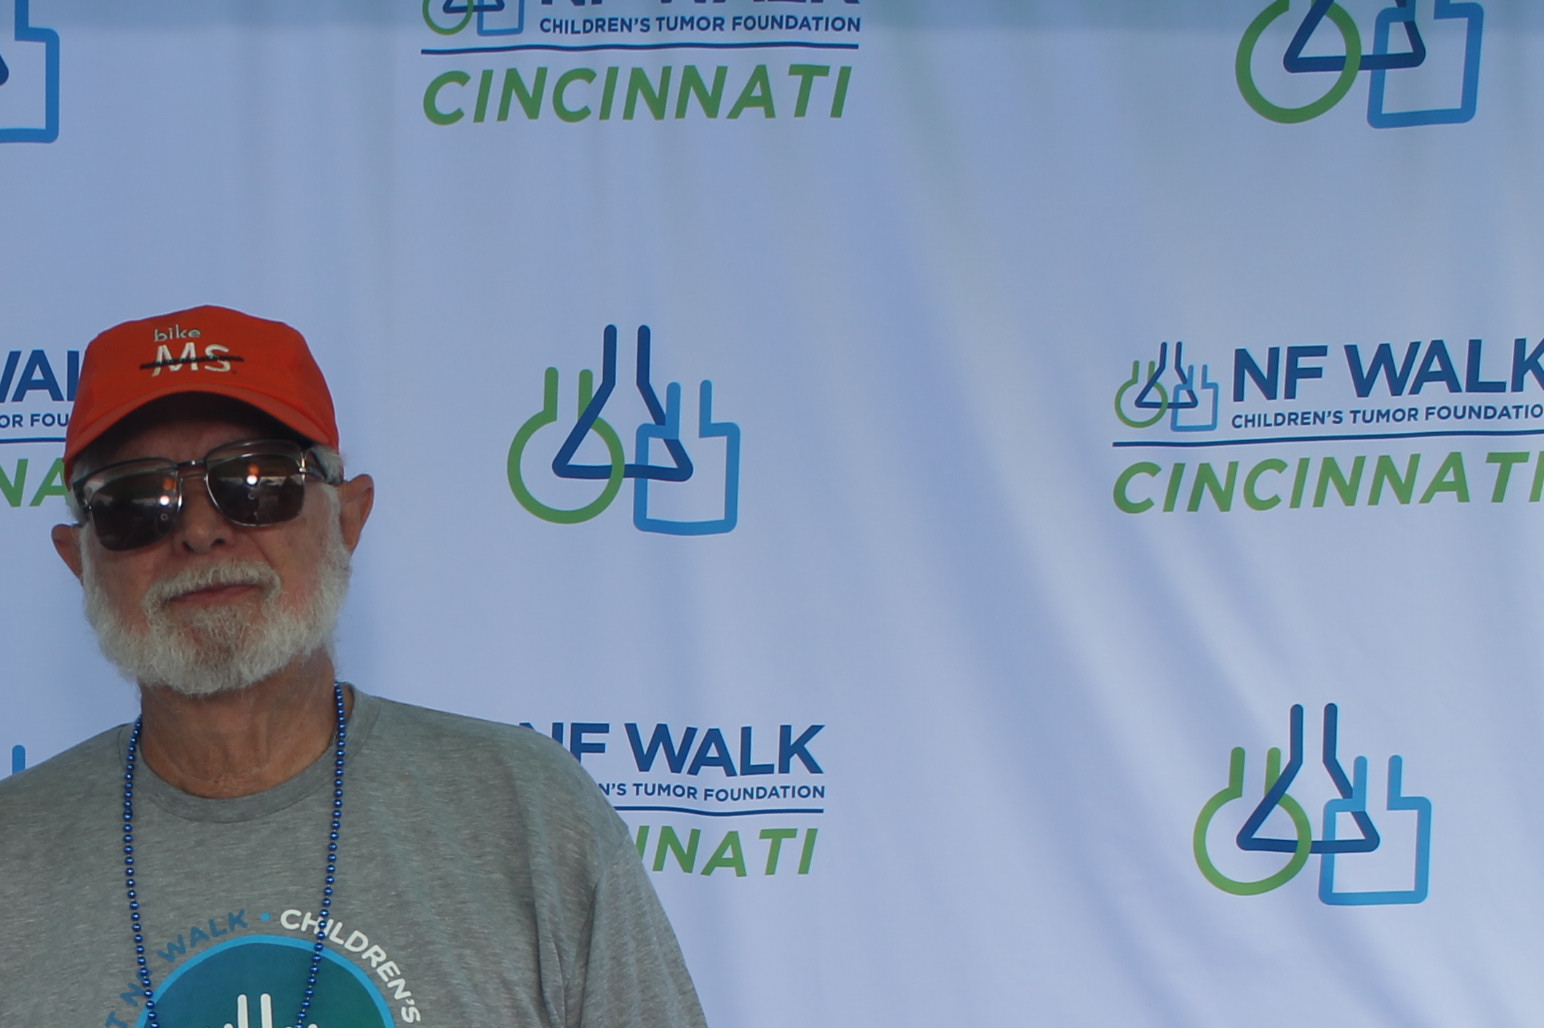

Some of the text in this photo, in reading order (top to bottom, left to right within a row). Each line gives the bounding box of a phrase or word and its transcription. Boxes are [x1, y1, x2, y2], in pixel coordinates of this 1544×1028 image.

[539, 14, 862, 35] CHILDREN'S TUMOR FOUNDATION
[422, 63, 853, 126] CINCINNATI
[154, 324, 201, 342] bike
[152, 342, 231, 377] MS
[1232, 337, 1544, 402] NF WALK
[1231, 404, 1544, 429] CHILDREN'S TUMOR FOUNDATIO
[624, 722, 826, 778] WALK
[634, 783, 698, 800] TUMOR
[703, 785, 826, 802] FOUNDATION
[157, 909, 248, 963] WALK
